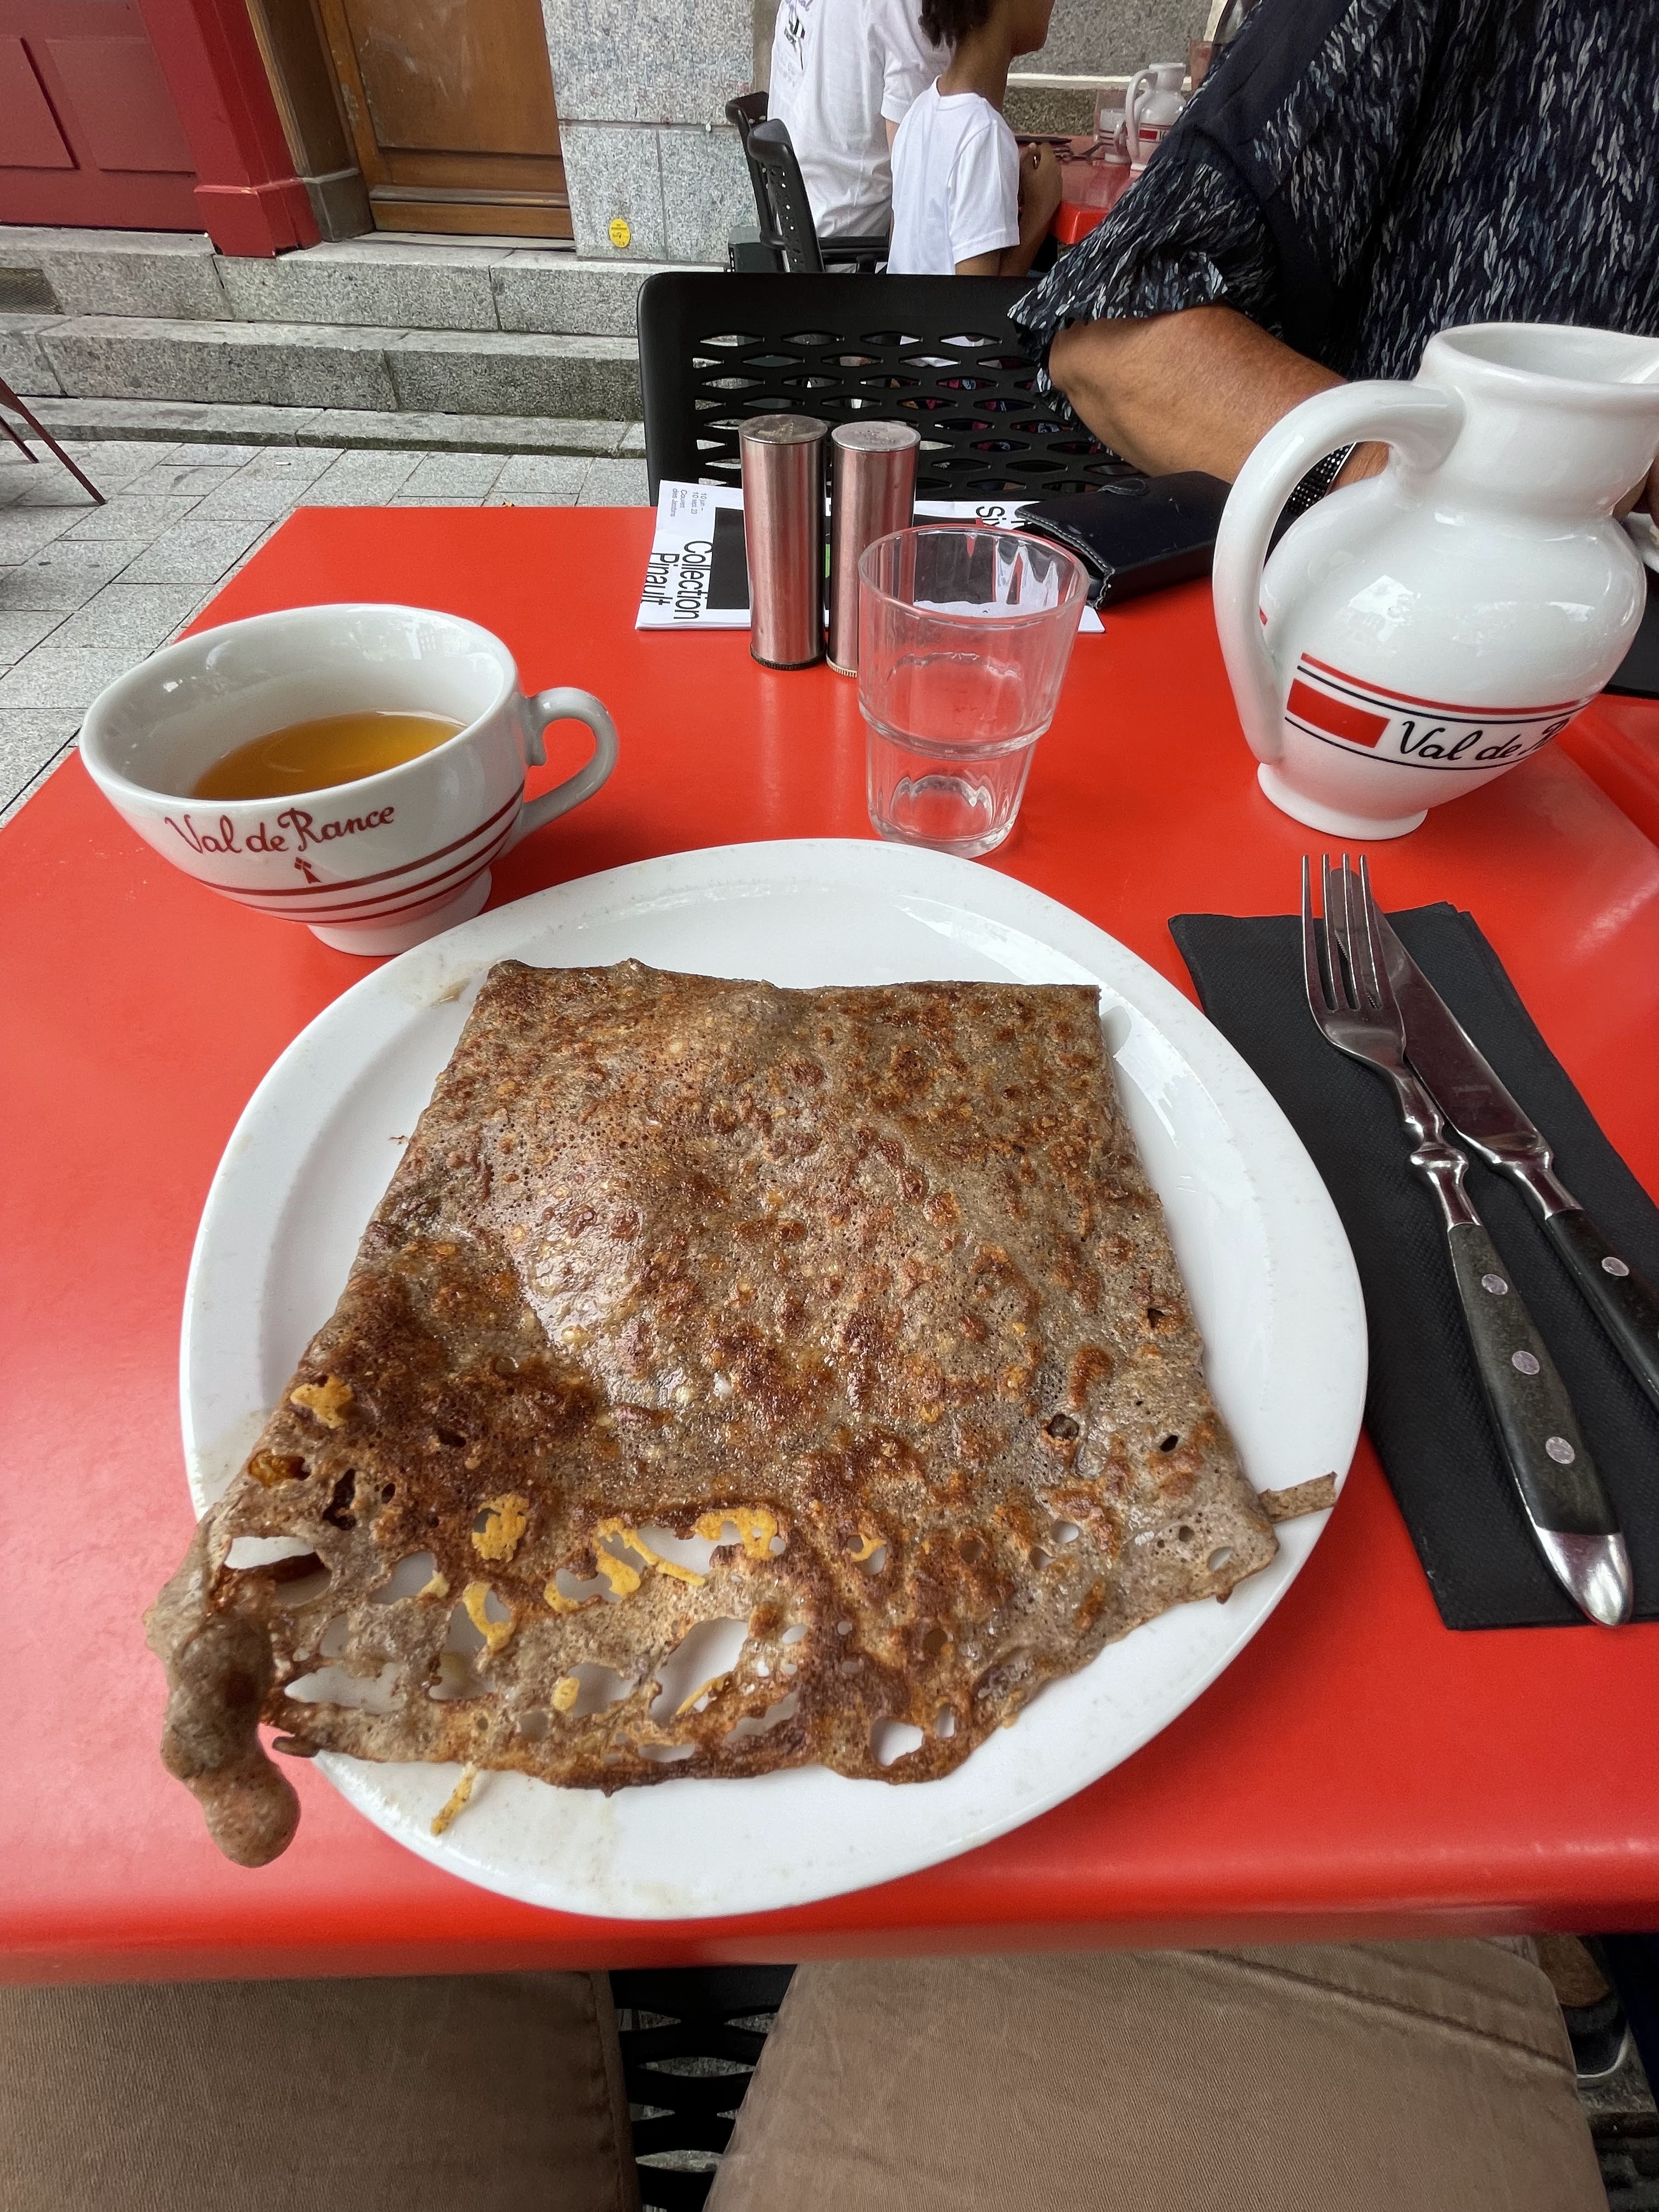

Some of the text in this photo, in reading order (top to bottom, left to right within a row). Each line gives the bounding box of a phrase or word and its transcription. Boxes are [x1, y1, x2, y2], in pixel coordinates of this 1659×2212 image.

[641, 552, 680, 606] Pinault
[674, 540, 713, 619] Collection
[1399, 720, 1482, 761] Val
[1475, 734, 1523, 761] de
[164, 806, 394, 854] Val de Rance
